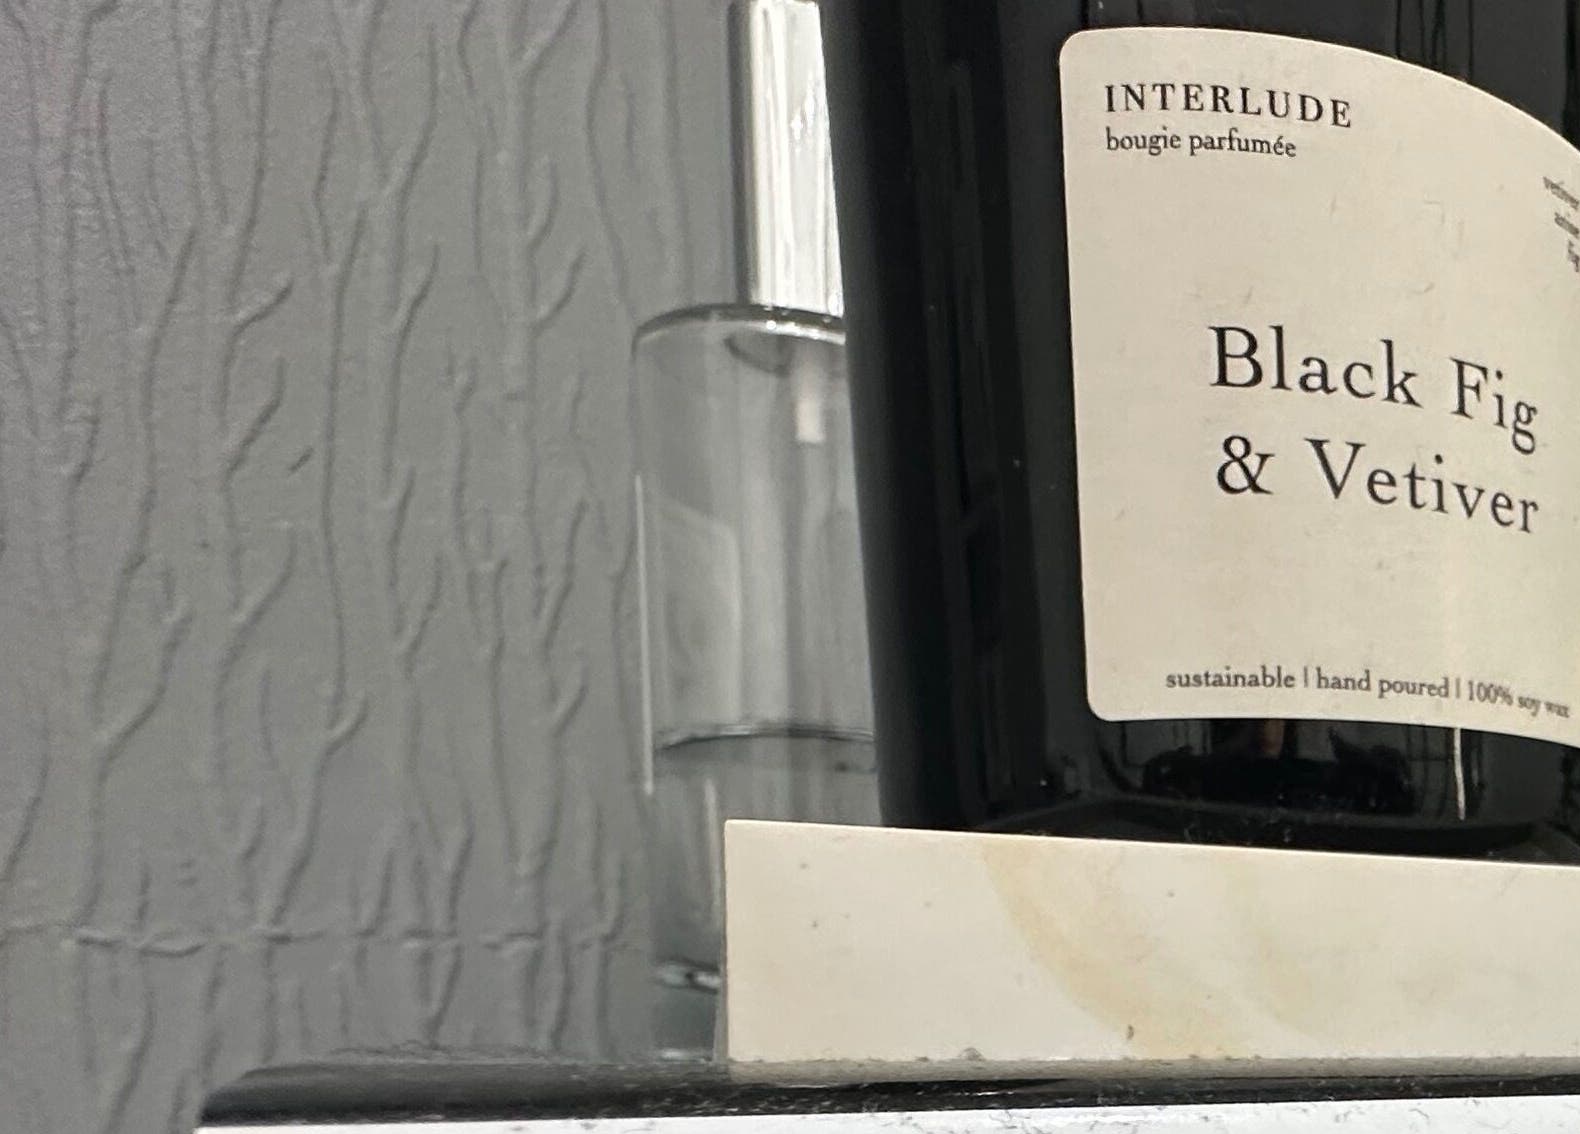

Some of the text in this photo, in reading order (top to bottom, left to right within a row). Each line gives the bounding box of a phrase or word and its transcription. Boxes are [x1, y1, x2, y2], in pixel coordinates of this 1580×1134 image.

[1104, 83, 1351, 128] INTERLUDE
[1105, 126, 1297, 158] bougie parfumée
[1208, 325, 1538, 455] Black Fig
[1216, 435, 1540, 534] & Vetiver
[1166, 664, 1296, 688] sustainable
[1316, 667, 1371, 691] hand
[1378, 677, 1449, 699] poured
[1468, 680, 1514, 706] 100%
[1518, 696, 1541, 717] soy
